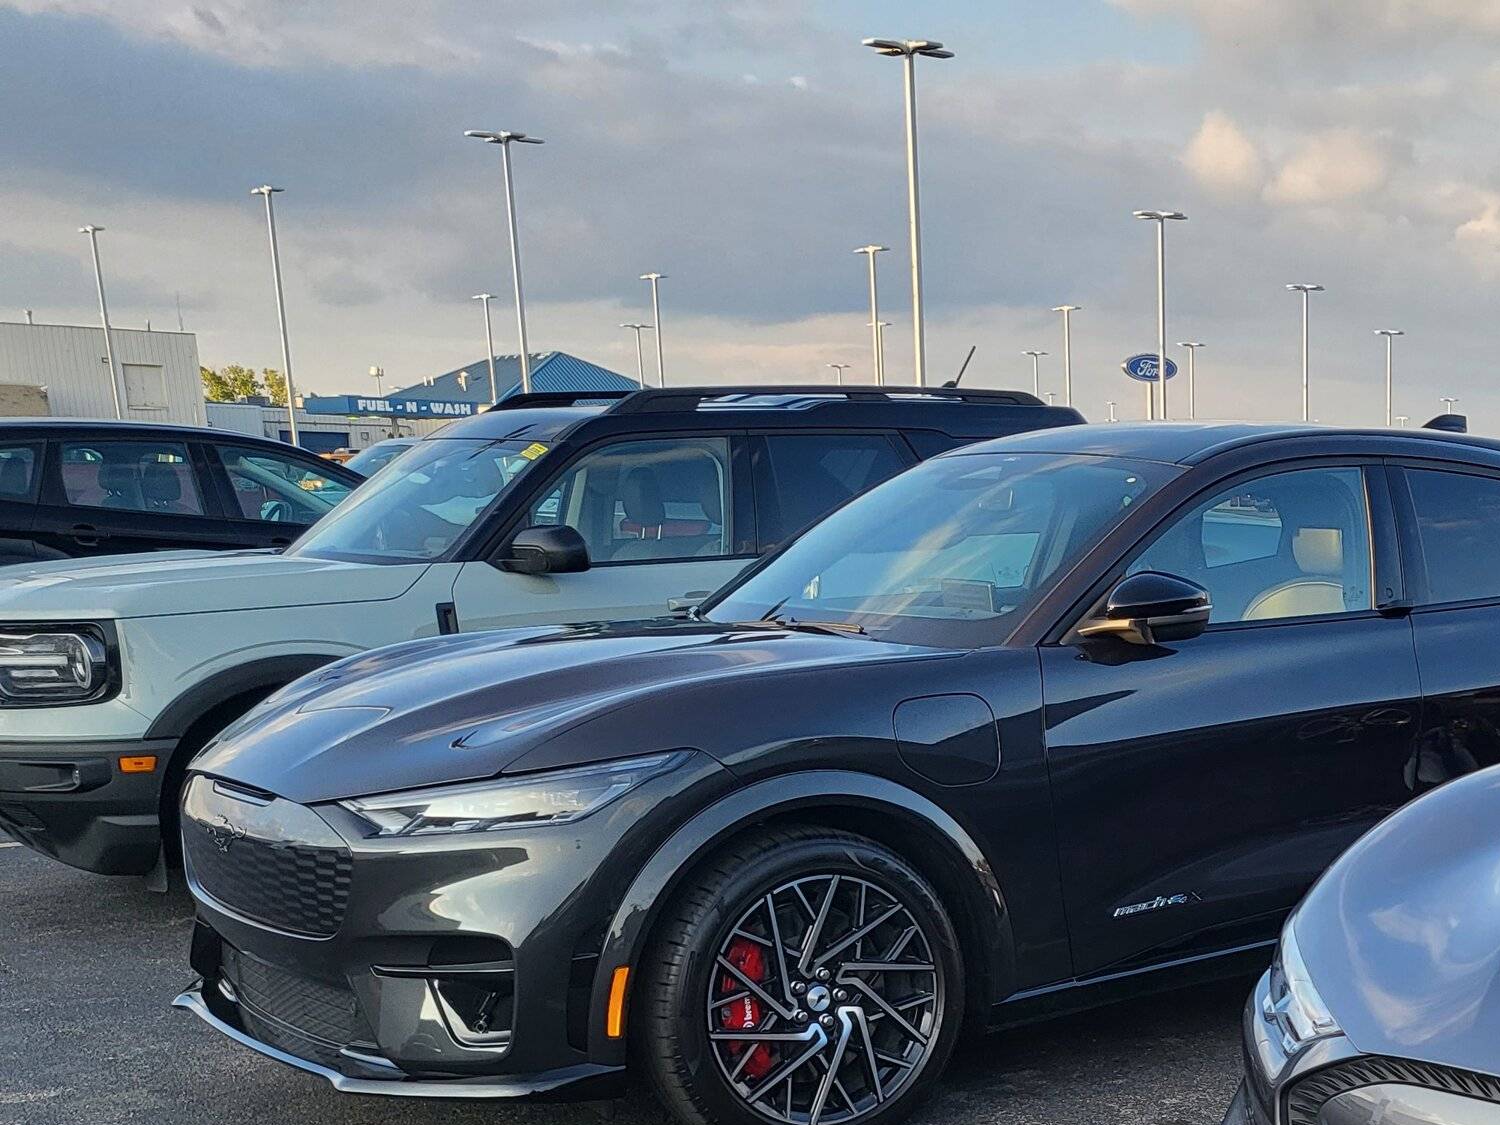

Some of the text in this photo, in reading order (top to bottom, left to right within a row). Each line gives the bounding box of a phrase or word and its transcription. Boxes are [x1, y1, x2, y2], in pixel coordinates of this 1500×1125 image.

[357, 399, 394, 412] FUEL
[405, 401, 418, 413] N
[429, 402, 471, 415] WASH
